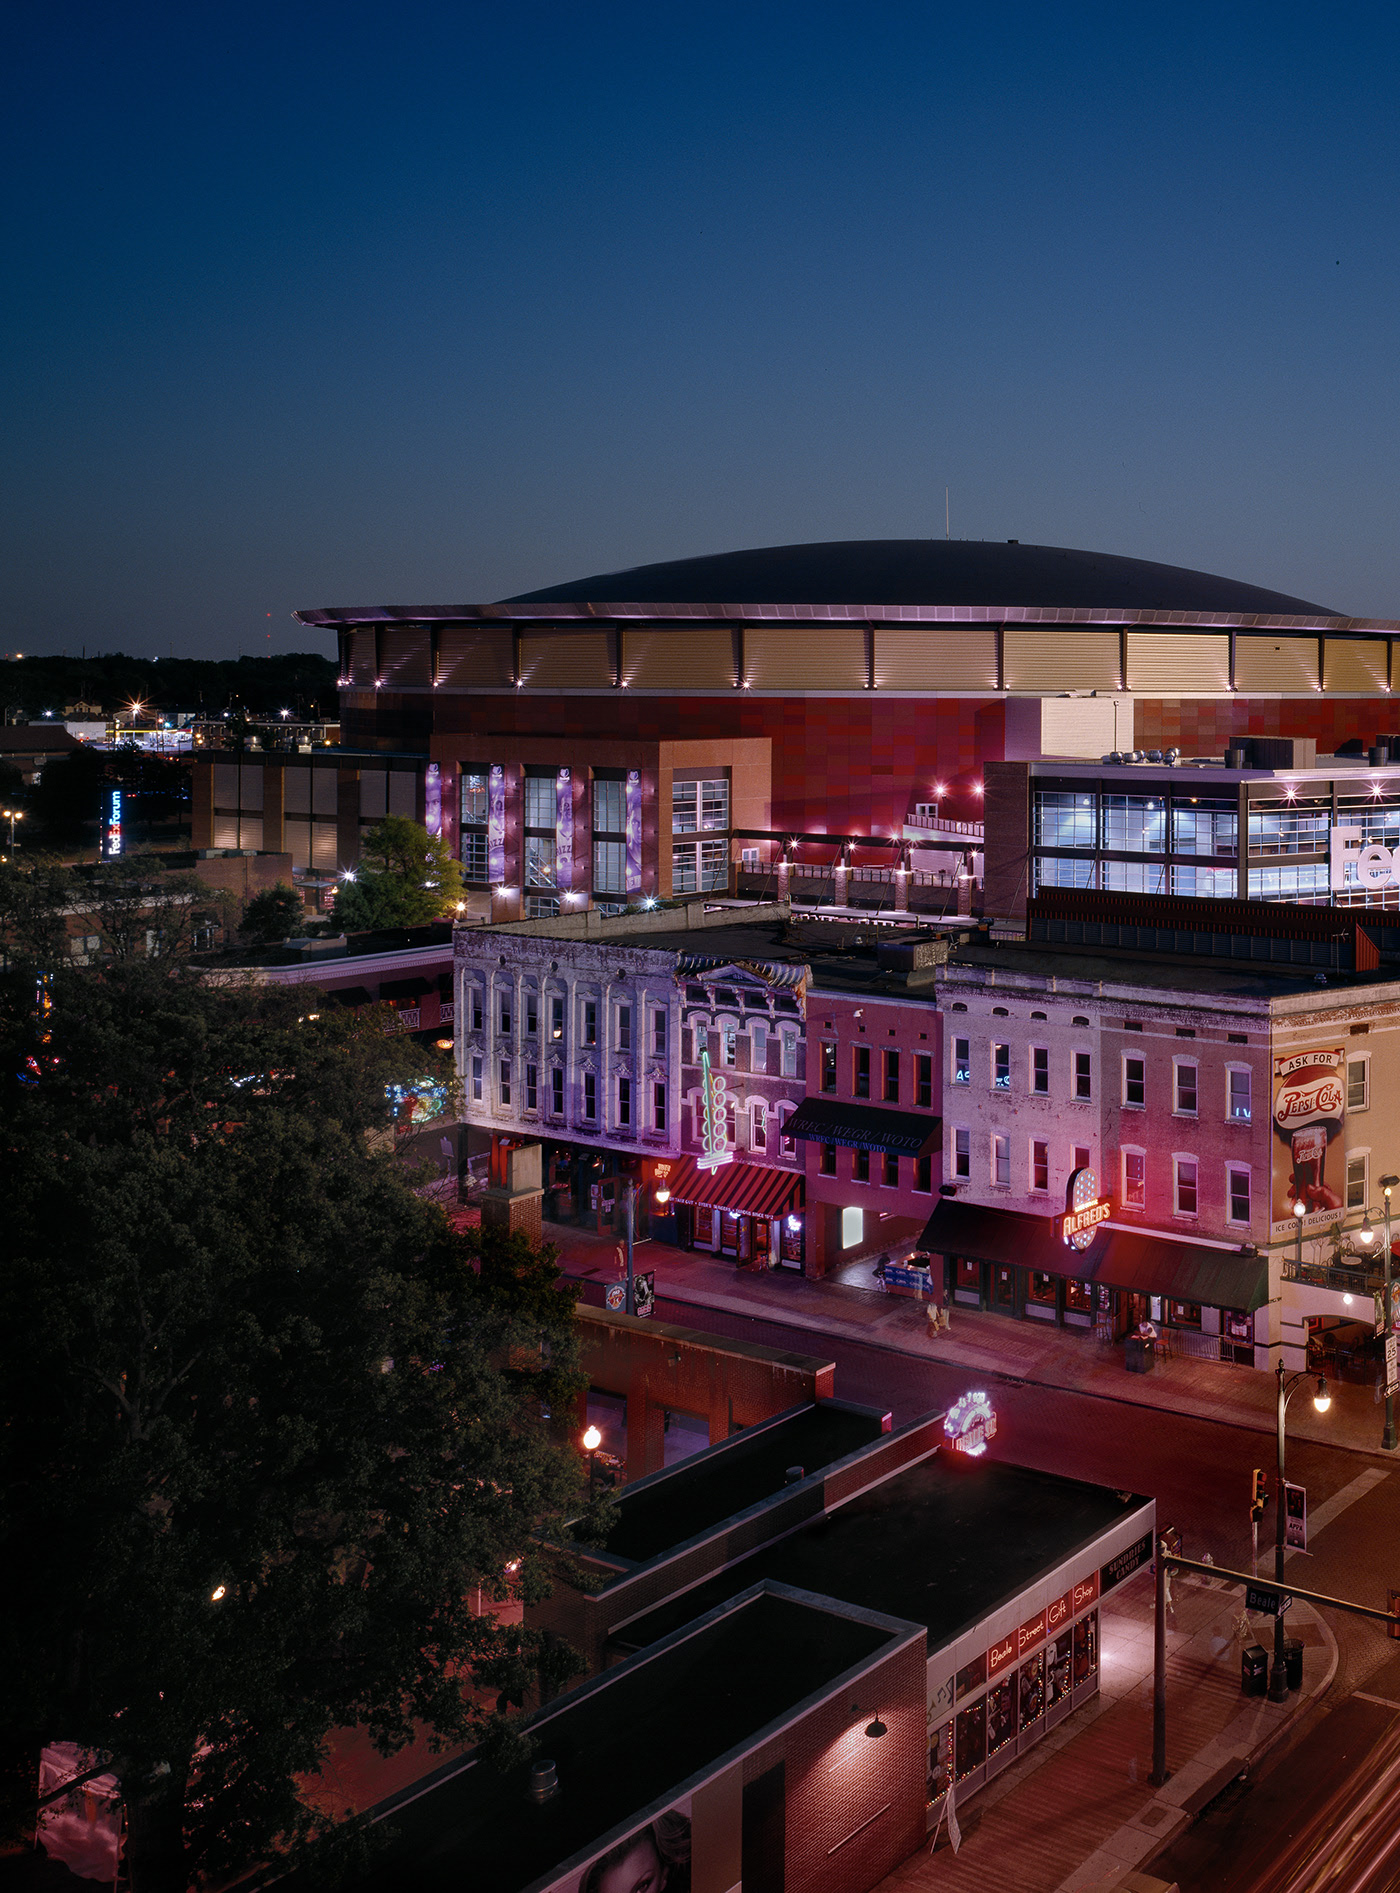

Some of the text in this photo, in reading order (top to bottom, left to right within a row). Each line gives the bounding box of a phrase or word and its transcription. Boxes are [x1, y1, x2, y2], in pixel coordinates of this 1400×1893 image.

[109, 791, 121, 855] FedExForum
[1288, 1054, 1332, 1070] ASK FOR
[880, 1132, 923, 1149] WOTO
[1063, 1203, 1110, 1237] ALFRED'S
[1308, 1212, 1342, 1225] DELICIOUS!
[1387, 1347, 1397, 1359] 25
[1109, 1540, 1146, 1575] SUNDRIES
[1116, 1556, 1139, 1580] CANDY
[1250, 1592, 1276, 1609] Beale
[990, 1585, 1093, 1668] Beale Street Gift Shop
